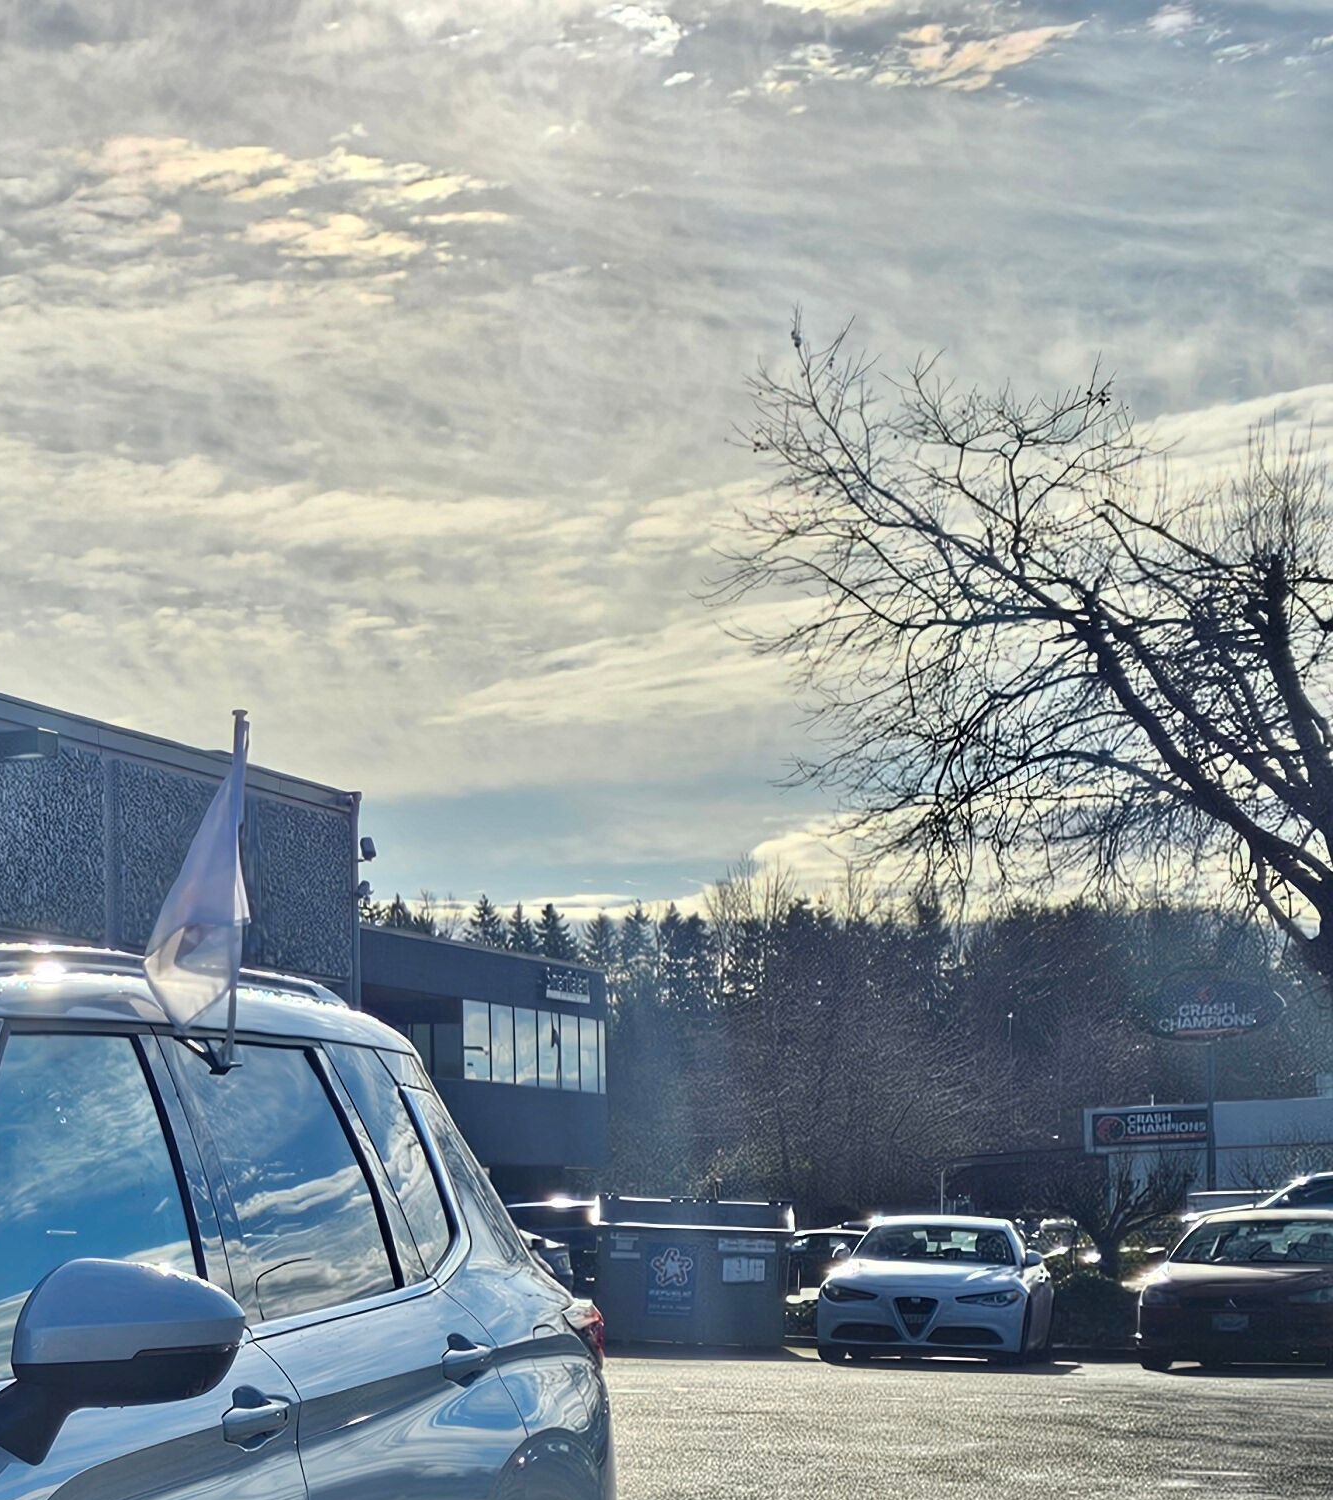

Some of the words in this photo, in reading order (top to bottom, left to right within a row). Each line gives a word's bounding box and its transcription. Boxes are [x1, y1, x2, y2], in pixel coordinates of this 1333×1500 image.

[1179, 1002, 1236, 1017] CRASH
[1158, 1013, 1256, 1032] CHAMPIONS
[1127, 1113, 1172, 1125] CRASH
[1127, 1121, 1207, 1135] CHAMPIONS
